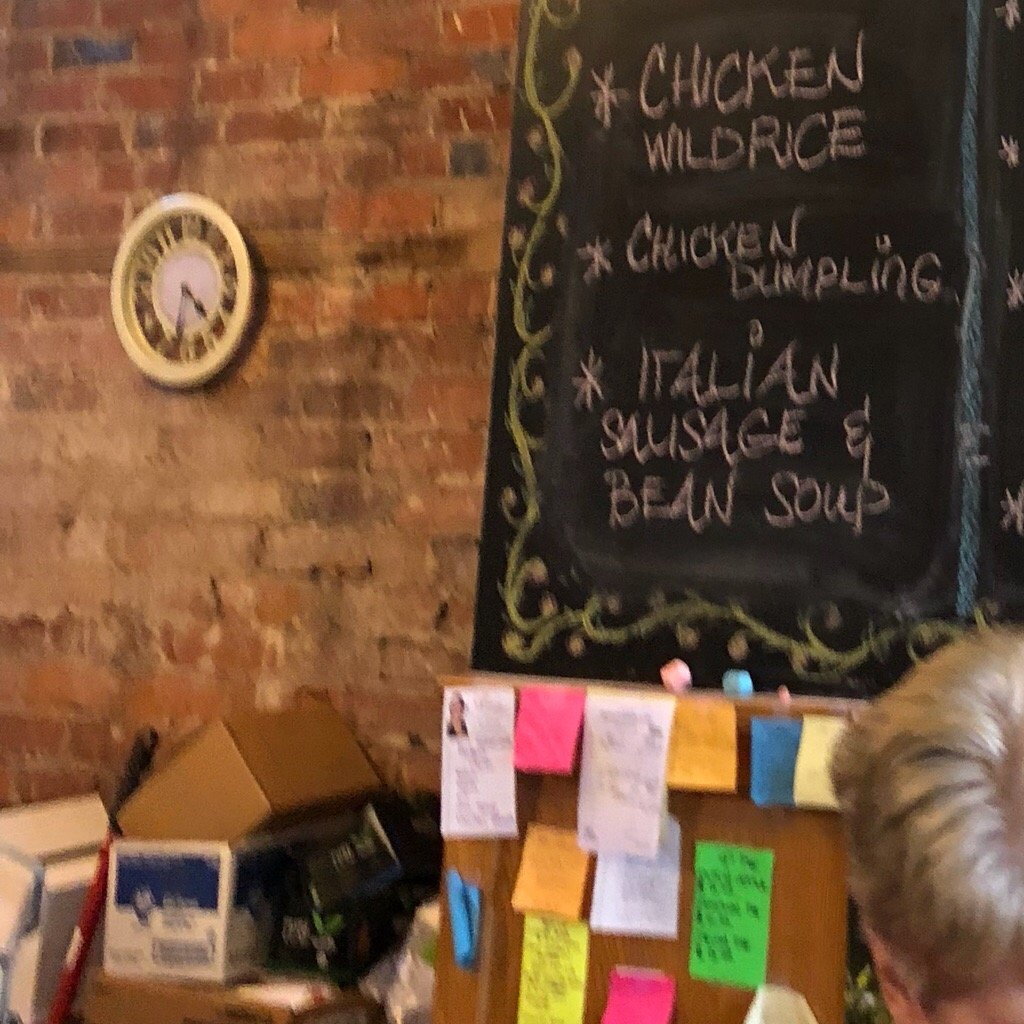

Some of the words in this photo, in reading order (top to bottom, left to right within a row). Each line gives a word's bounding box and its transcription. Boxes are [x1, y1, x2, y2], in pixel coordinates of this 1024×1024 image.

[640, 29, 866, 120] CHICKEN
[626, 205, 805, 274] CHICKEN
[601, 407, 807, 468] SAUSAGE
[603, 469, 738, 535] BEAN
[764, 471, 892, 536] SOUP
